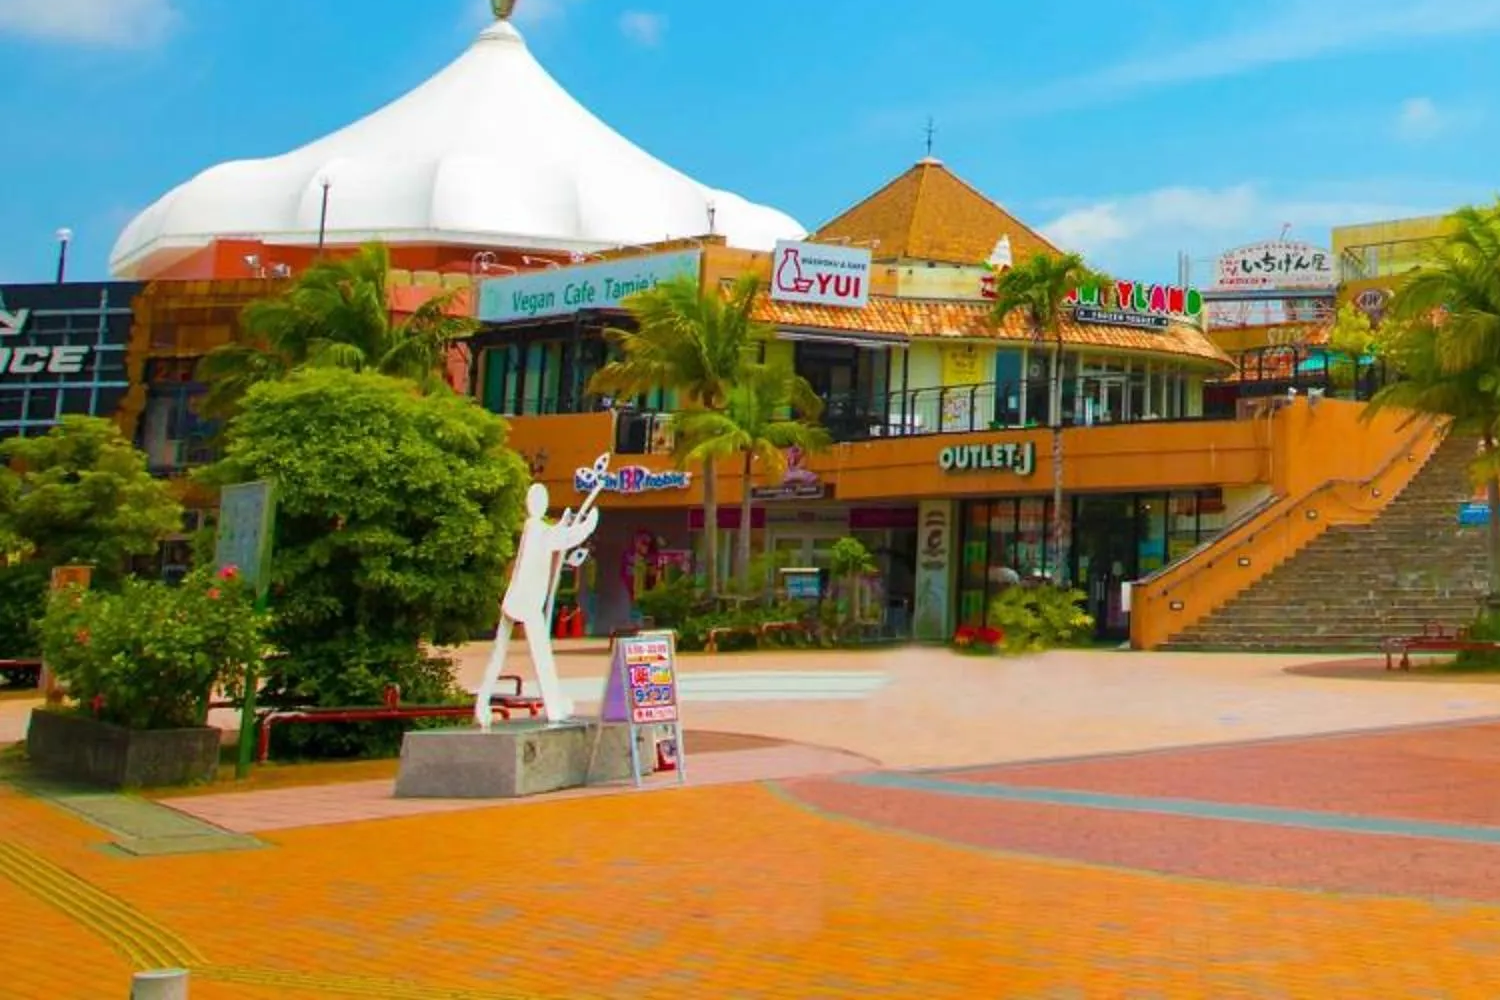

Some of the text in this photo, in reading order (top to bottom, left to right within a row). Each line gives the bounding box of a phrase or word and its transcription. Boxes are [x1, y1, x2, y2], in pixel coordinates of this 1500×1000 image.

[513, 289, 554, 315] Vegan
[564, 281, 595, 305] Cafe
[816, 272, 861, 298] YUI
